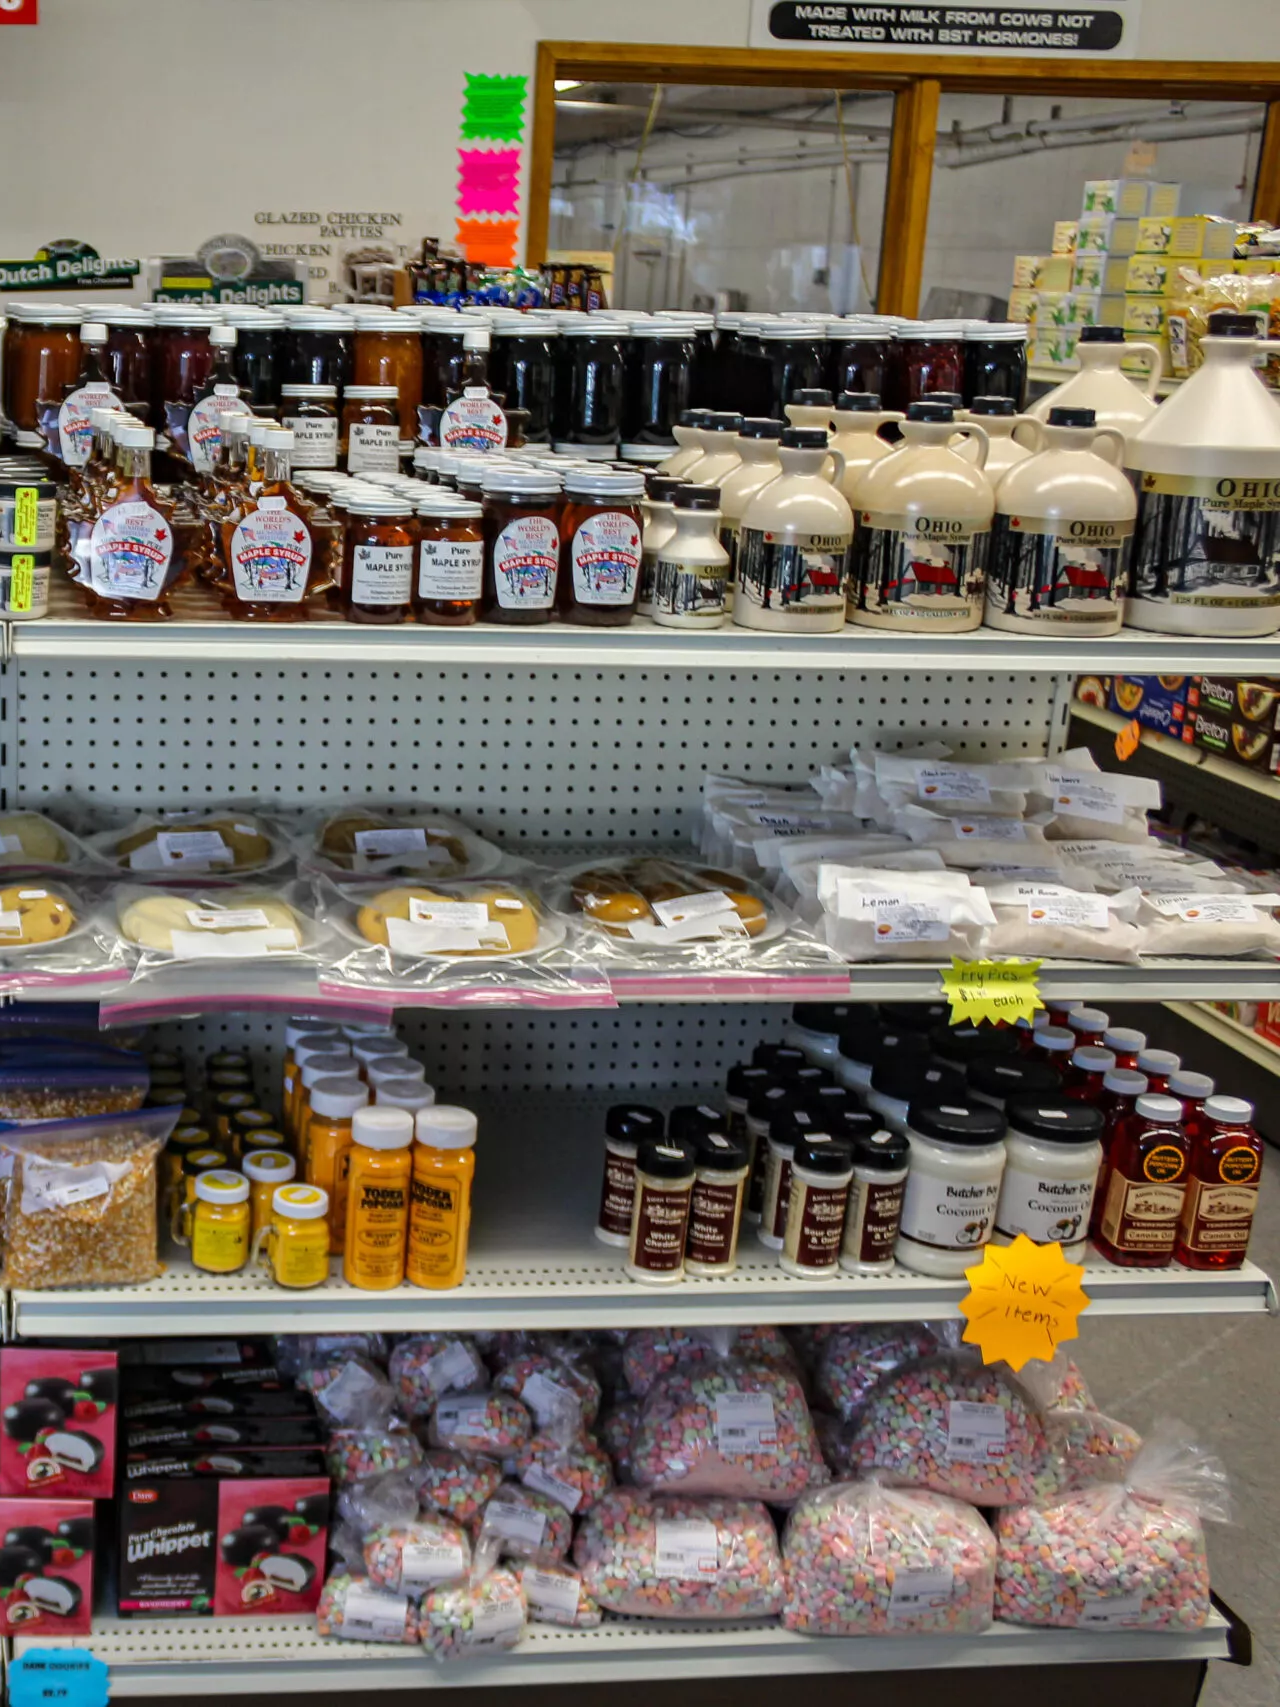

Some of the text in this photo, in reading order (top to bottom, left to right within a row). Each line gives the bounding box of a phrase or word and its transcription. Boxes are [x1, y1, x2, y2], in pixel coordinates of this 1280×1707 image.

[795, 5, 1095, 29] MADE WITH MILK FROM COWS NOT
[808, 24, 1079, 47] TREATED WITH BST HORMONES!
[254, 212, 403, 226] GLAZED CHICKEN
[320, 225, 384, 238] PATTIES
[56, 256, 138, 279] Delights
[220, 284, 301, 305] Delights
[305, 422, 324, 430] Pure
[376, 428, 392, 437] Pure
[294, 431, 314, 440] APLE
[359, 438, 383, 446] MAPLE
[446, 429, 474, 443] MAPLE
[1202, 497, 1265, 511] Pure Maple
[255, 516, 292, 524] WORLD'S
[595, 519, 630, 528] WORLD'S
[915, 516, 962, 534] OHIO
[517, 525, 550, 533] WORLD'S
[1070, 521, 1115, 537] OHIO
[810, 534, 842, 546] OHIO
[901, 531, 947, 543] Pure Maple
[1055, 536, 1101, 545] Pure Maple
[98, 543, 164, 563] MAPLE SYRUP
[239, 547, 306, 565] MAPLE SYRUP
[385, 551, 404, 560] Pure
[450, 547, 471, 556] Pure
[431, 558, 459, 568] MAPLE
[502, 557, 533, 571] MAPLE
[577, 552, 638, 567] MAPLE SYRUP
[365, 562, 393, 572] MAPLE
[1201, 676, 1234, 703] Breton
[1195, 715, 1229, 742] Breton
[961, 971, 984, 988] Fry
[993, 994, 1024, 1007] each
[1149, 1161, 1179, 1169] POPCORN
[946, 1186, 984, 1199] Butcher
[1038, 1182, 1077, 1195] Butcher
[361, 1198, 404, 1209] POPCORN
[1028, 1200, 1078, 1213] Coconut
[936, 1204, 986, 1217] Coconut
[693, 1223, 718, 1233] White
[804, 1226, 825, 1237] Sour
[650, 1232, 676, 1241] White
[690, 1229, 724, 1241] Cheddar
[1129, 1231, 1173, 1239] Canola Oil
[1203, 1231, 1246, 1240] Canola Oil
[645, 1238, 681, 1248] Cheddar
[1002, 1273, 1052, 1297] New
[1005, 1305, 1059, 1327] Items
[127, 1522, 196, 1544] Pure Chocolate
[126, 1532, 211, 1563] Whippet
